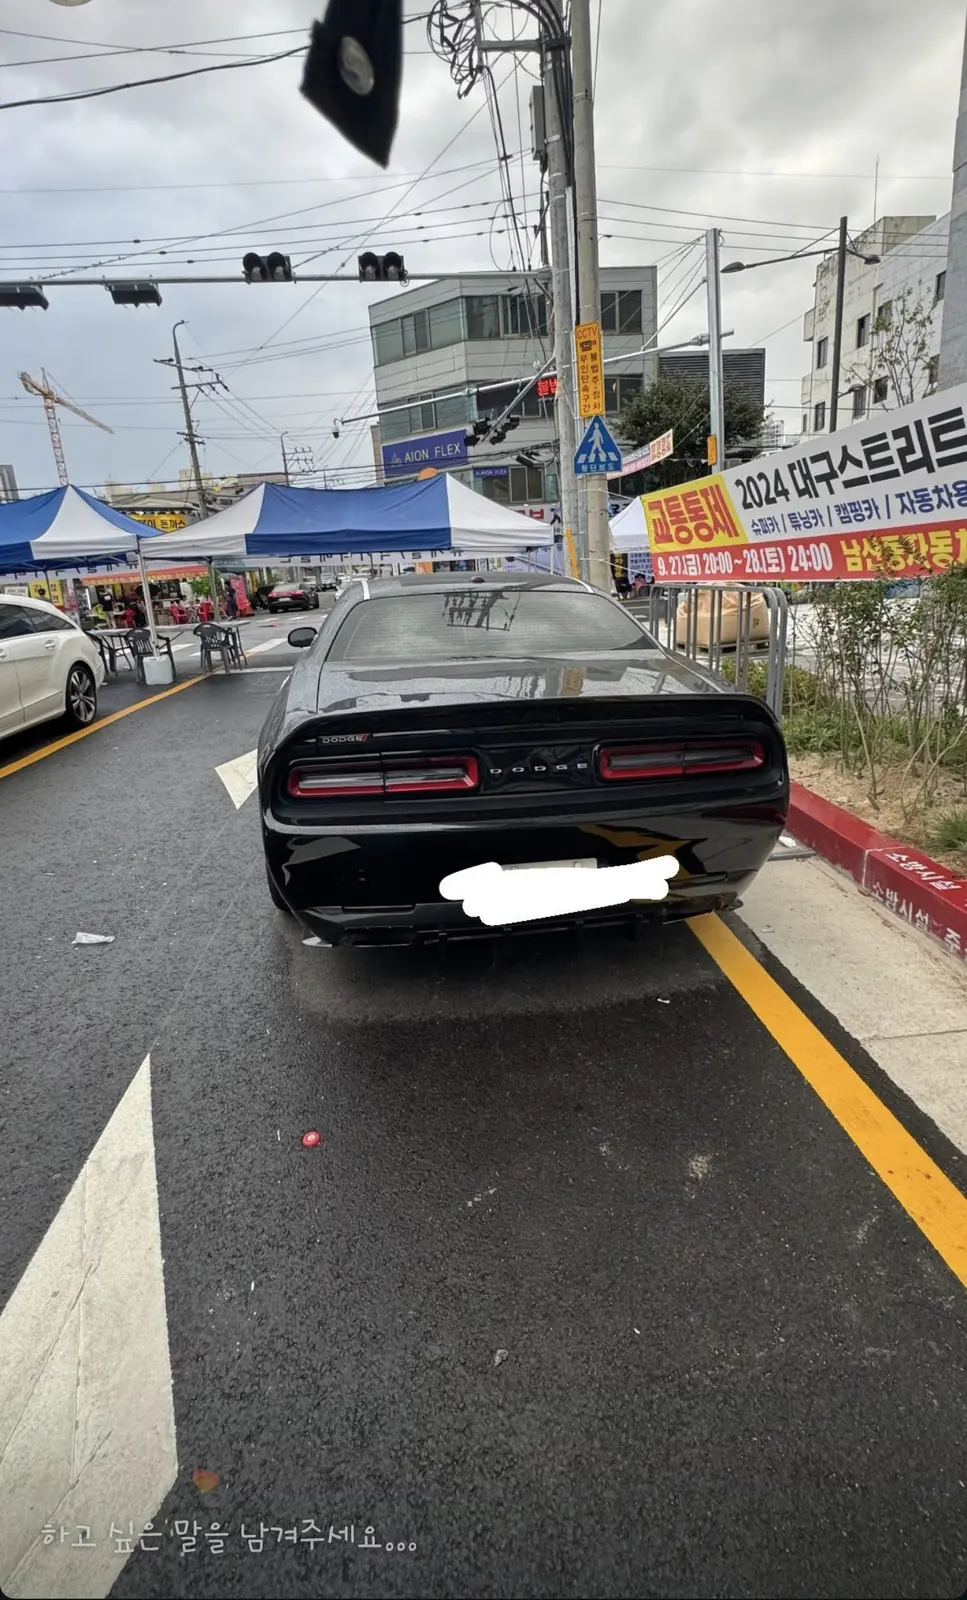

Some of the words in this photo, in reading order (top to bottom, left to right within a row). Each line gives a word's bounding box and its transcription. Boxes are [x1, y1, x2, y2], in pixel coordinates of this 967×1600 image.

[577, 325, 597, 340] CCTV
[404, 449, 429, 463] AION
[435, 442, 461, 457] FLEX
[734, 468, 790, 510] 2024
[787, 406, 967, 499] 대구스트리트
[581, 462, 615, 473] 횡단보도
[647, 483, 740, 545] 교통통제
[751, 513, 782, 536] 슈퍼카
[787, 508, 825, 531] 튜닝카
[834, 498, 881, 525] 캠핑카
[895, 480, 967, 515] 자동차용
[160, 519, 186, 529] 돈까스
[788, 542, 833, 573] 24:00
[322, 735, 363, 744] DODGE
[490, 761, 590, 776] DODGE
[886, 853, 963, 891] 소방시설
[871, 881, 930, 931] 소방시설
[944, 927, 967, 960] 주
